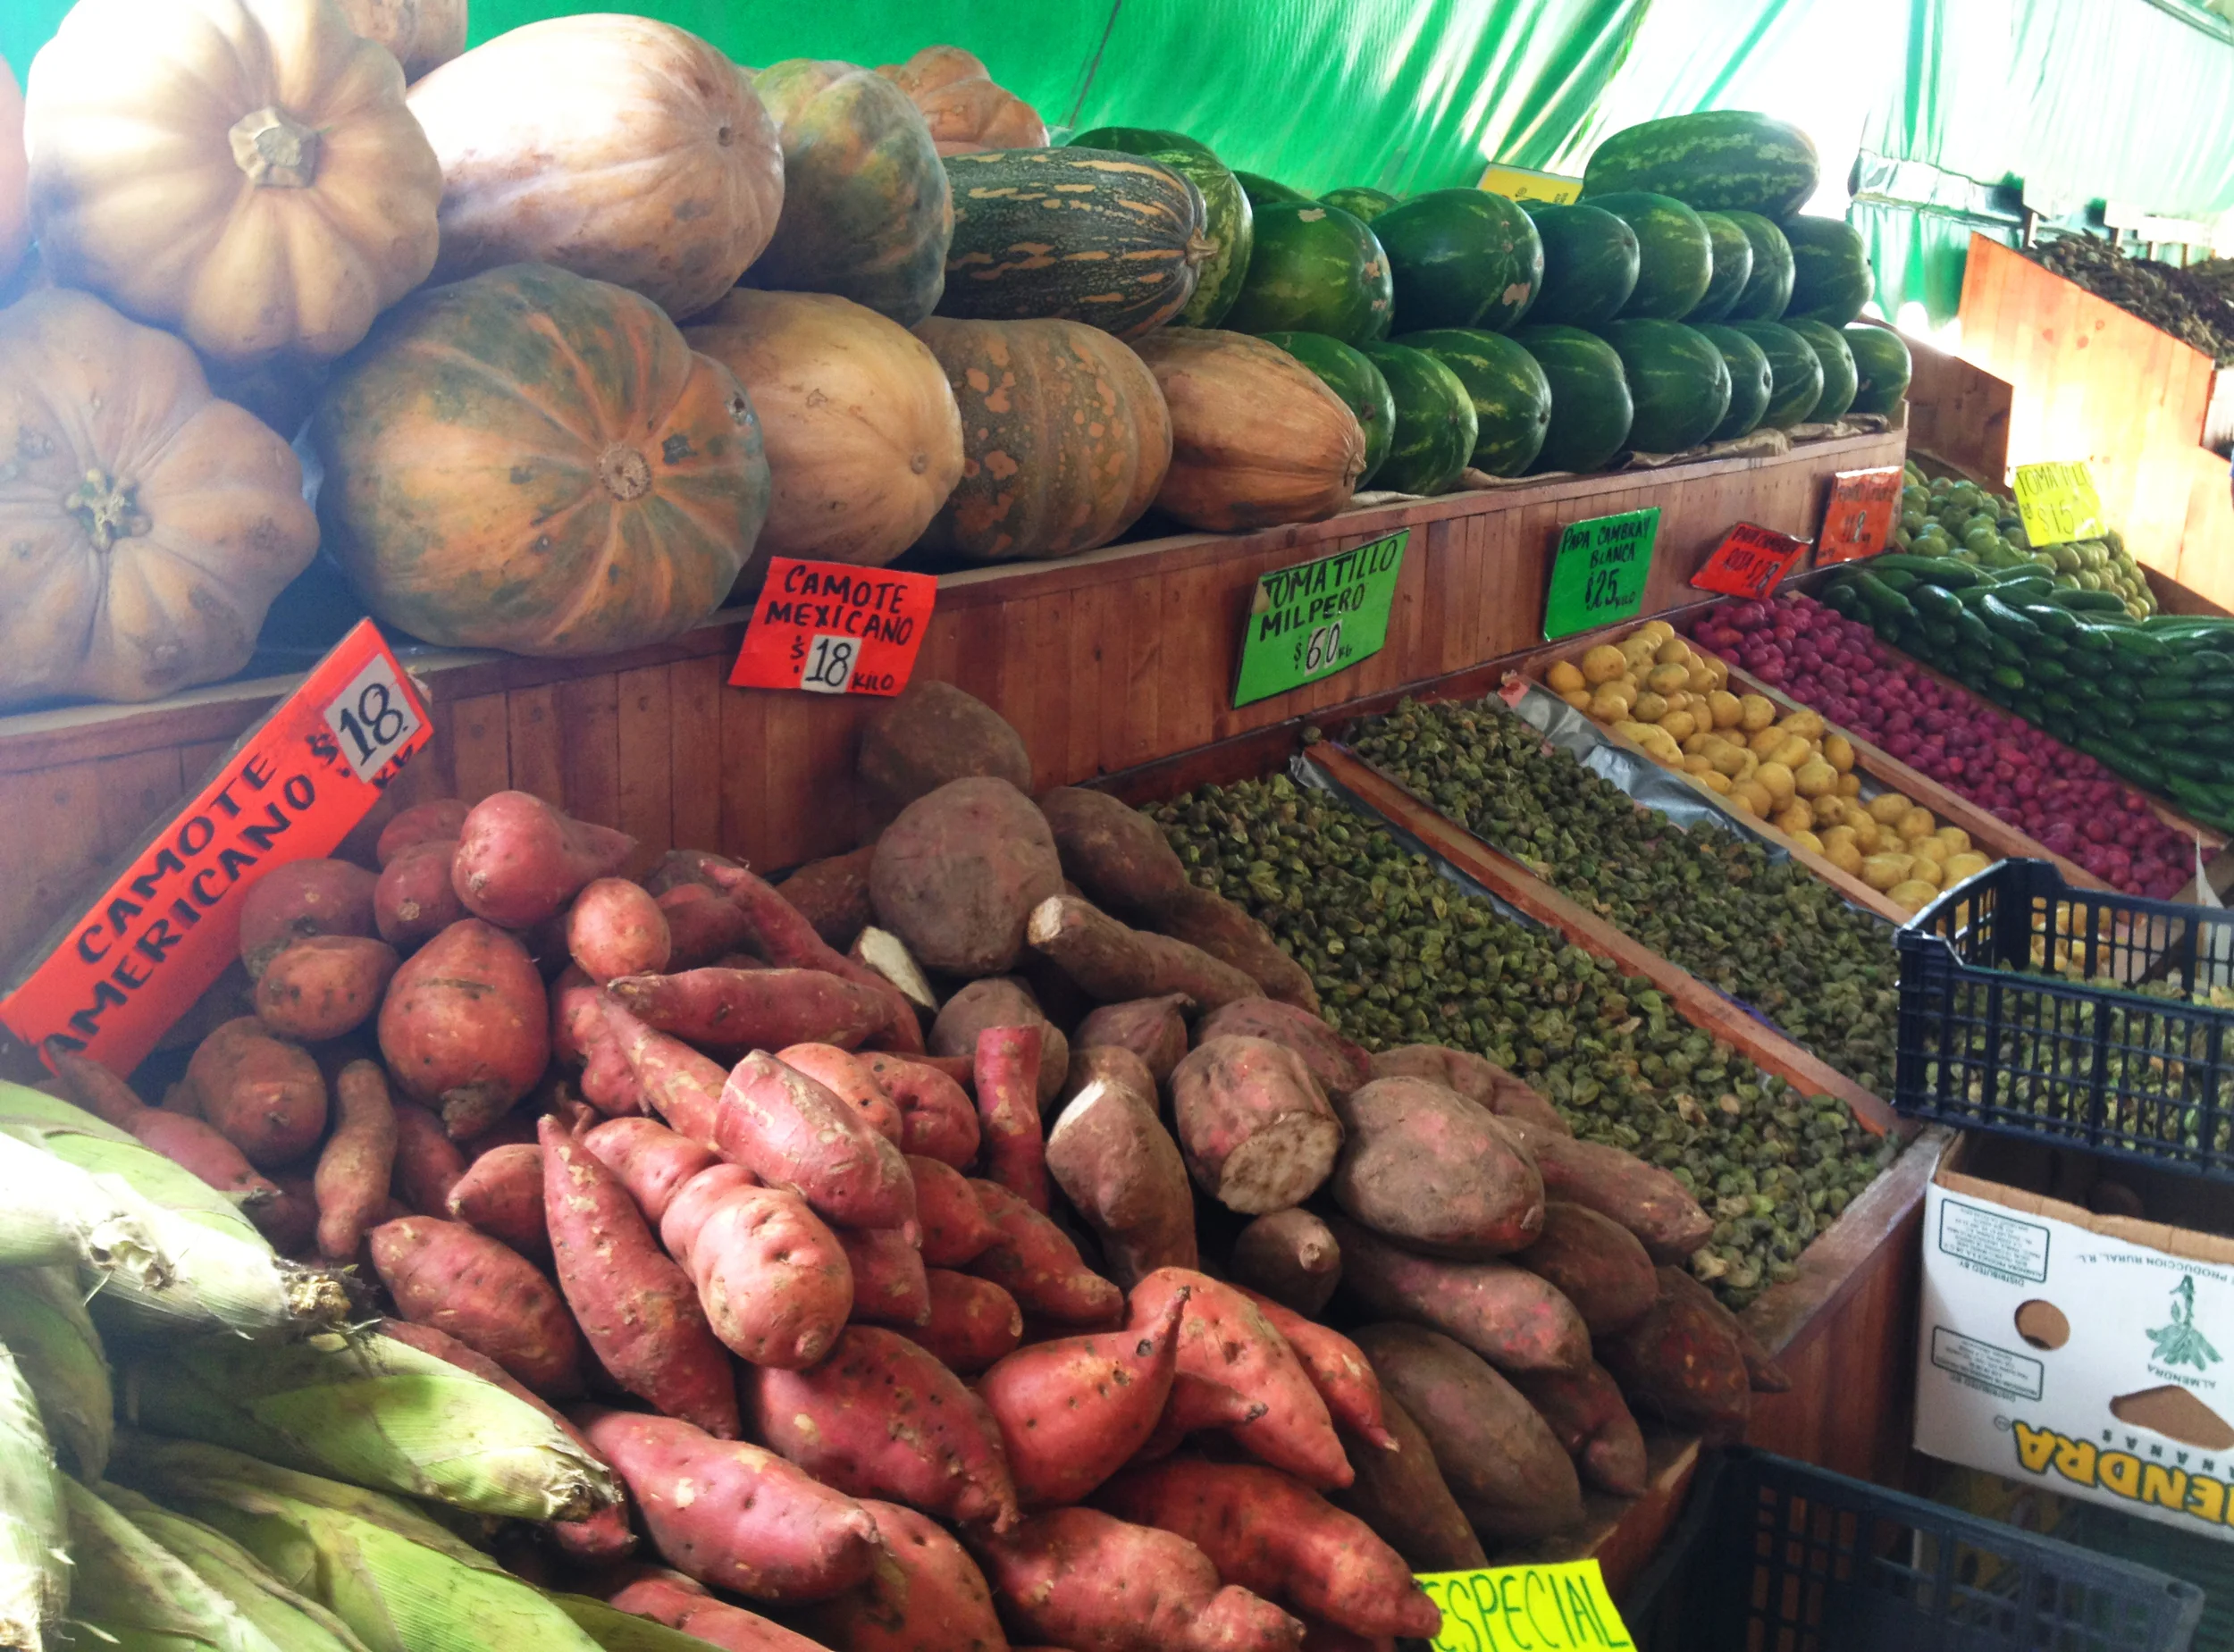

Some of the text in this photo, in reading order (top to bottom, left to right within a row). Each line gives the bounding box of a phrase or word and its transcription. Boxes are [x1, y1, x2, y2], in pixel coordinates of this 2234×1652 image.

[1561, 517, 1651, 554] PAPA CAMBRAY
[1590, 542, 1635, 568] BLANCA
[784, 565, 909, 614] CAMOTE
[1262, 539, 1398, 608] TOMATILLO
[765, 600, 914, 646] MEXICANO
[1259, 583, 1365, 642] MILPERO
[851, 671, 894, 692] KILO
[77, 751, 277, 964] CAMOTE
[44, 774, 316, 1052] AMERICANO
[1971, 1264, 2025, 1287] DISTRIBUTED
[2146, 1257, 2228, 1282] PRODUCCION
[2147, 1363, 2217, 1389] ALMENDRA
[2011, 1419, 2234, 1530] ENDRA
